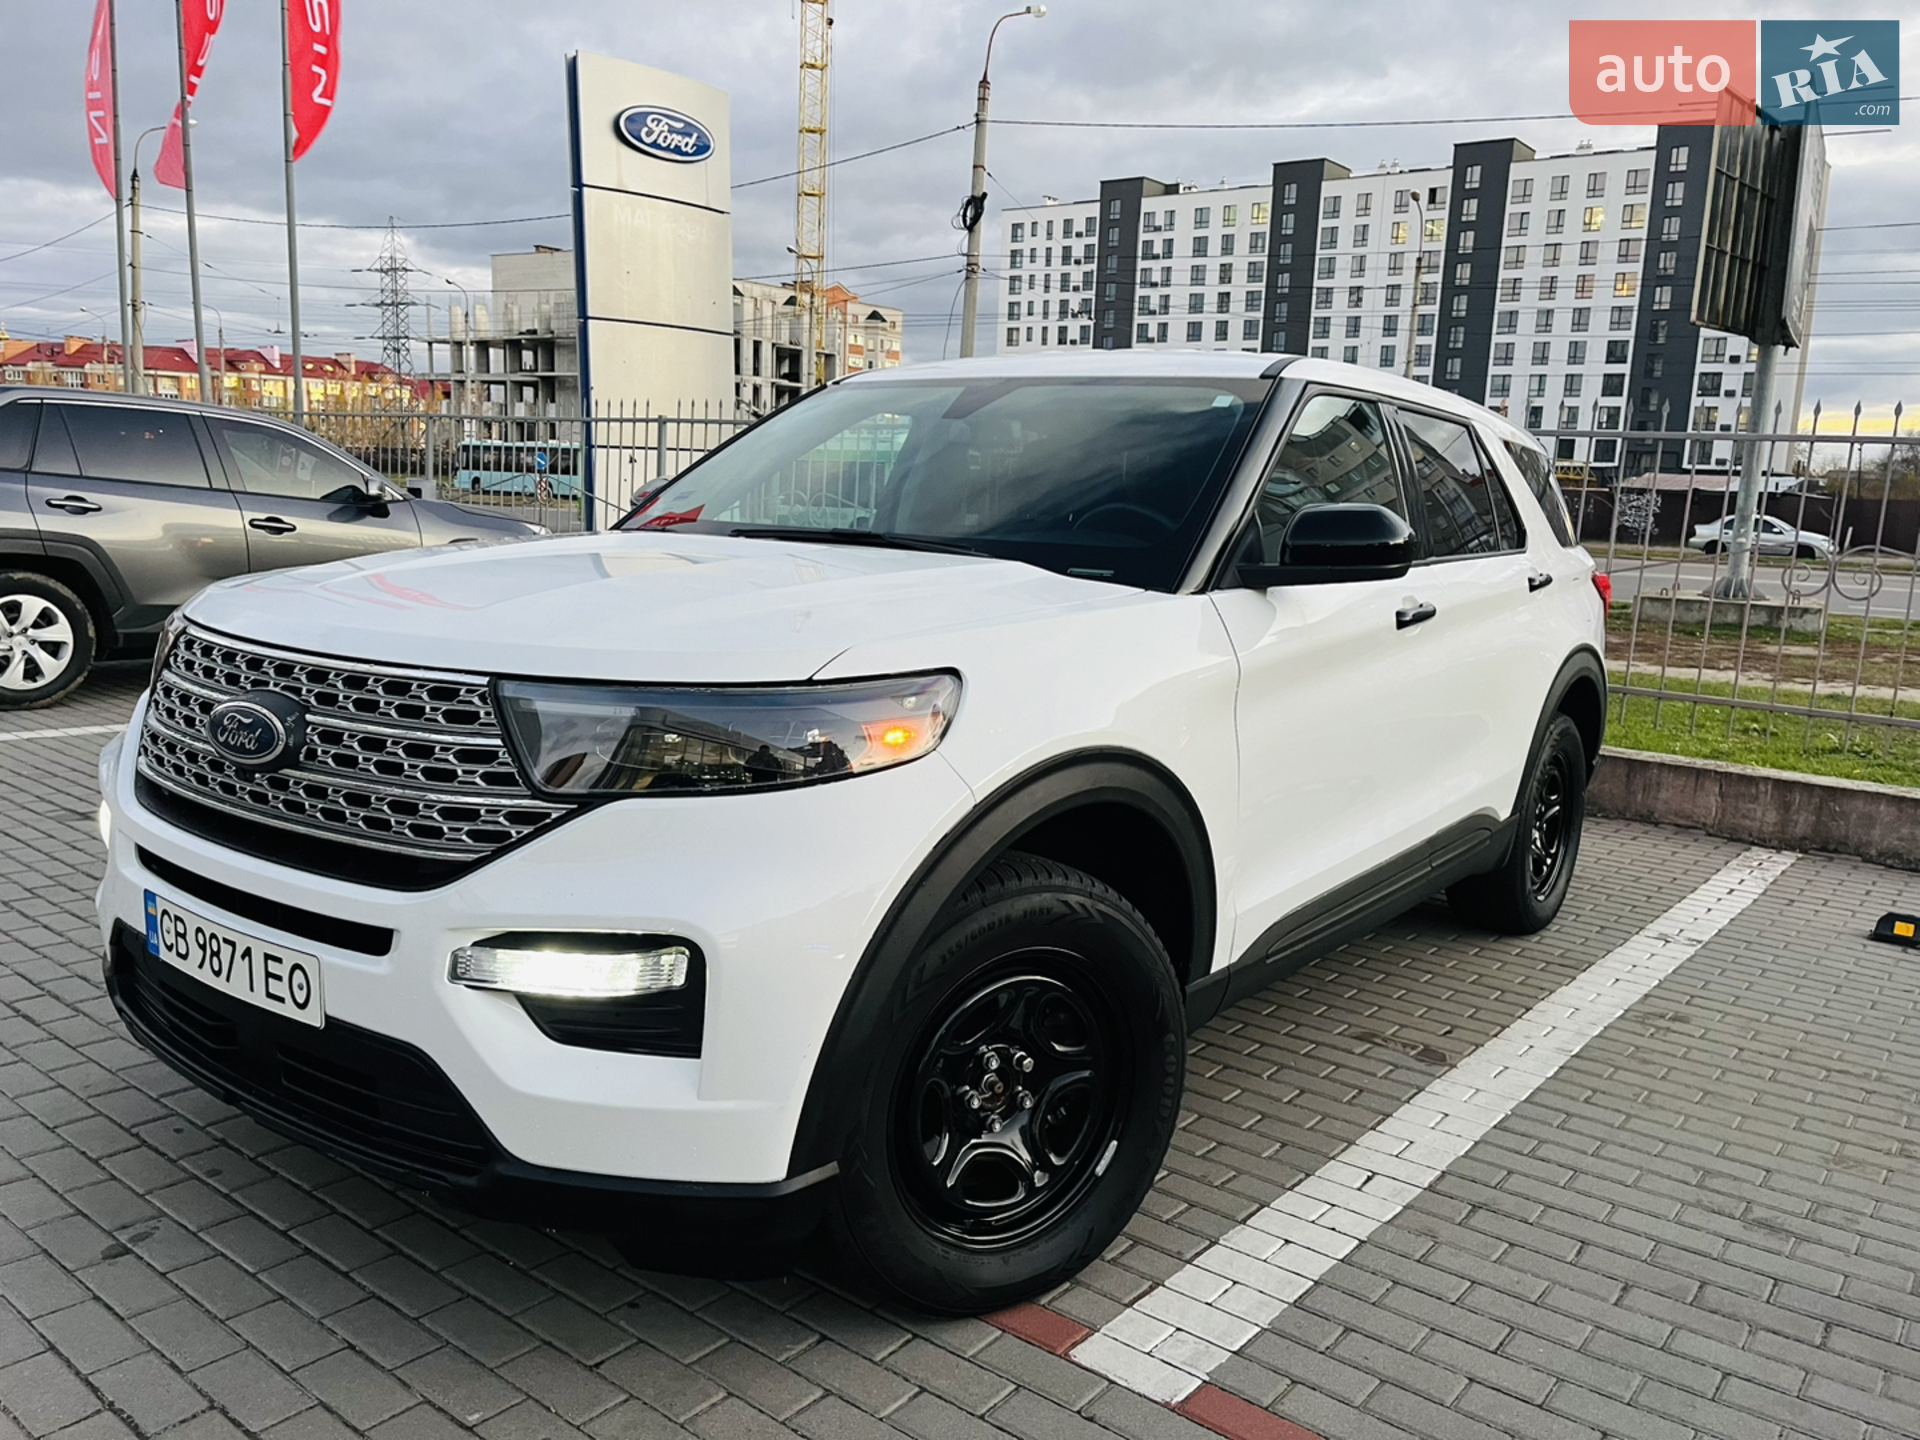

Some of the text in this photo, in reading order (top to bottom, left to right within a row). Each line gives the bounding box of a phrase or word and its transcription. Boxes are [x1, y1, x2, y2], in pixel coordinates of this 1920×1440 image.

[640, 113, 699, 154] Ford
[217, 712, 262, 751] Ford
[159, 908, 190, 961] CB
[194, 926, 255, 993] 9871
